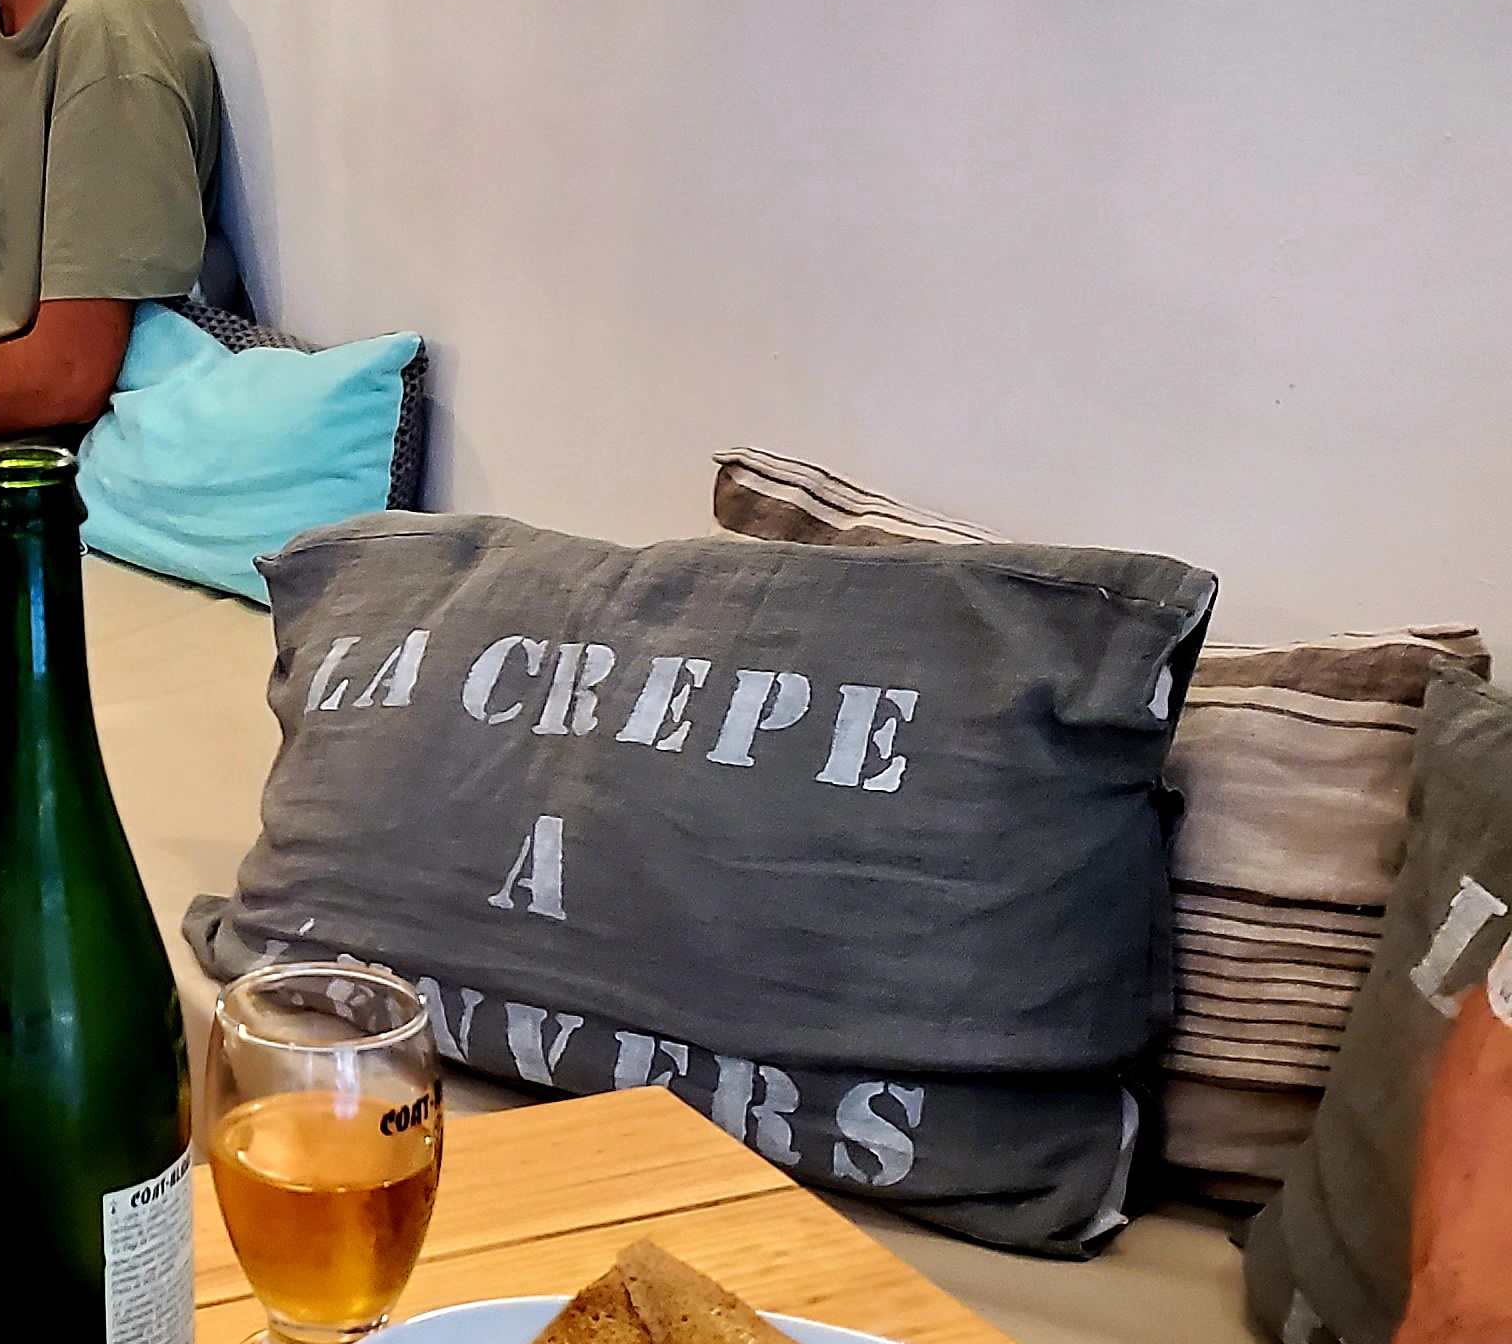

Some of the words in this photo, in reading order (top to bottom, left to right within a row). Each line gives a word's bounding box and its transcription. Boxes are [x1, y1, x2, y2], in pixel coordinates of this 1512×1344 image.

[304, 629, 432, 713] LA
[461, 635, 921, 794] CREPE
[488, 814, 568, 921] A
